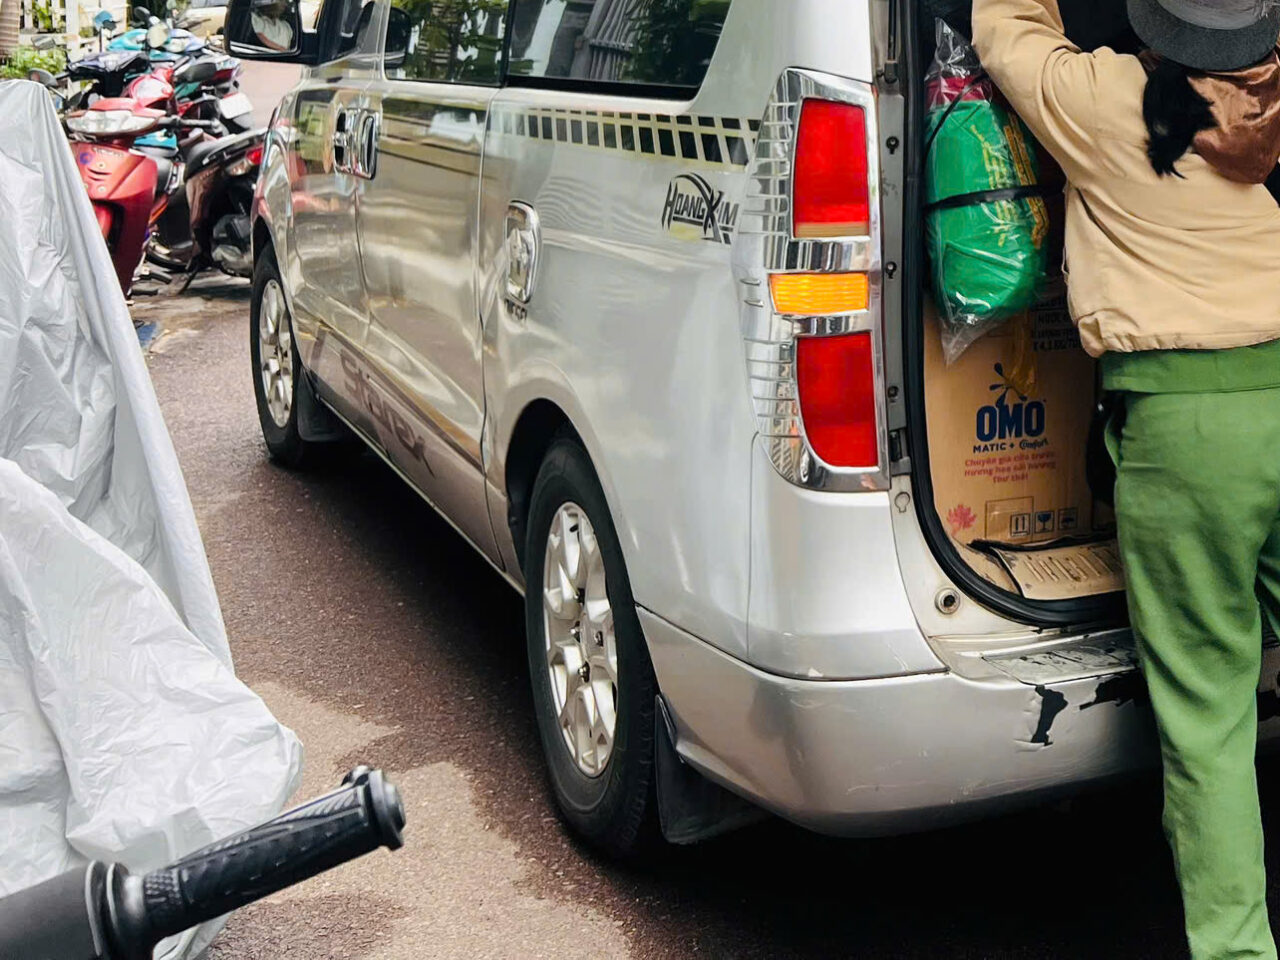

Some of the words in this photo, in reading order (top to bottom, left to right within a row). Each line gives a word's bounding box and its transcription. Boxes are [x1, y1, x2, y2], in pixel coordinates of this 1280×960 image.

[976, 401, 1046, 442] OMO
[973, 443, 1007, 454] MATIC
[1019, 438, 1049, 450] Comfort
